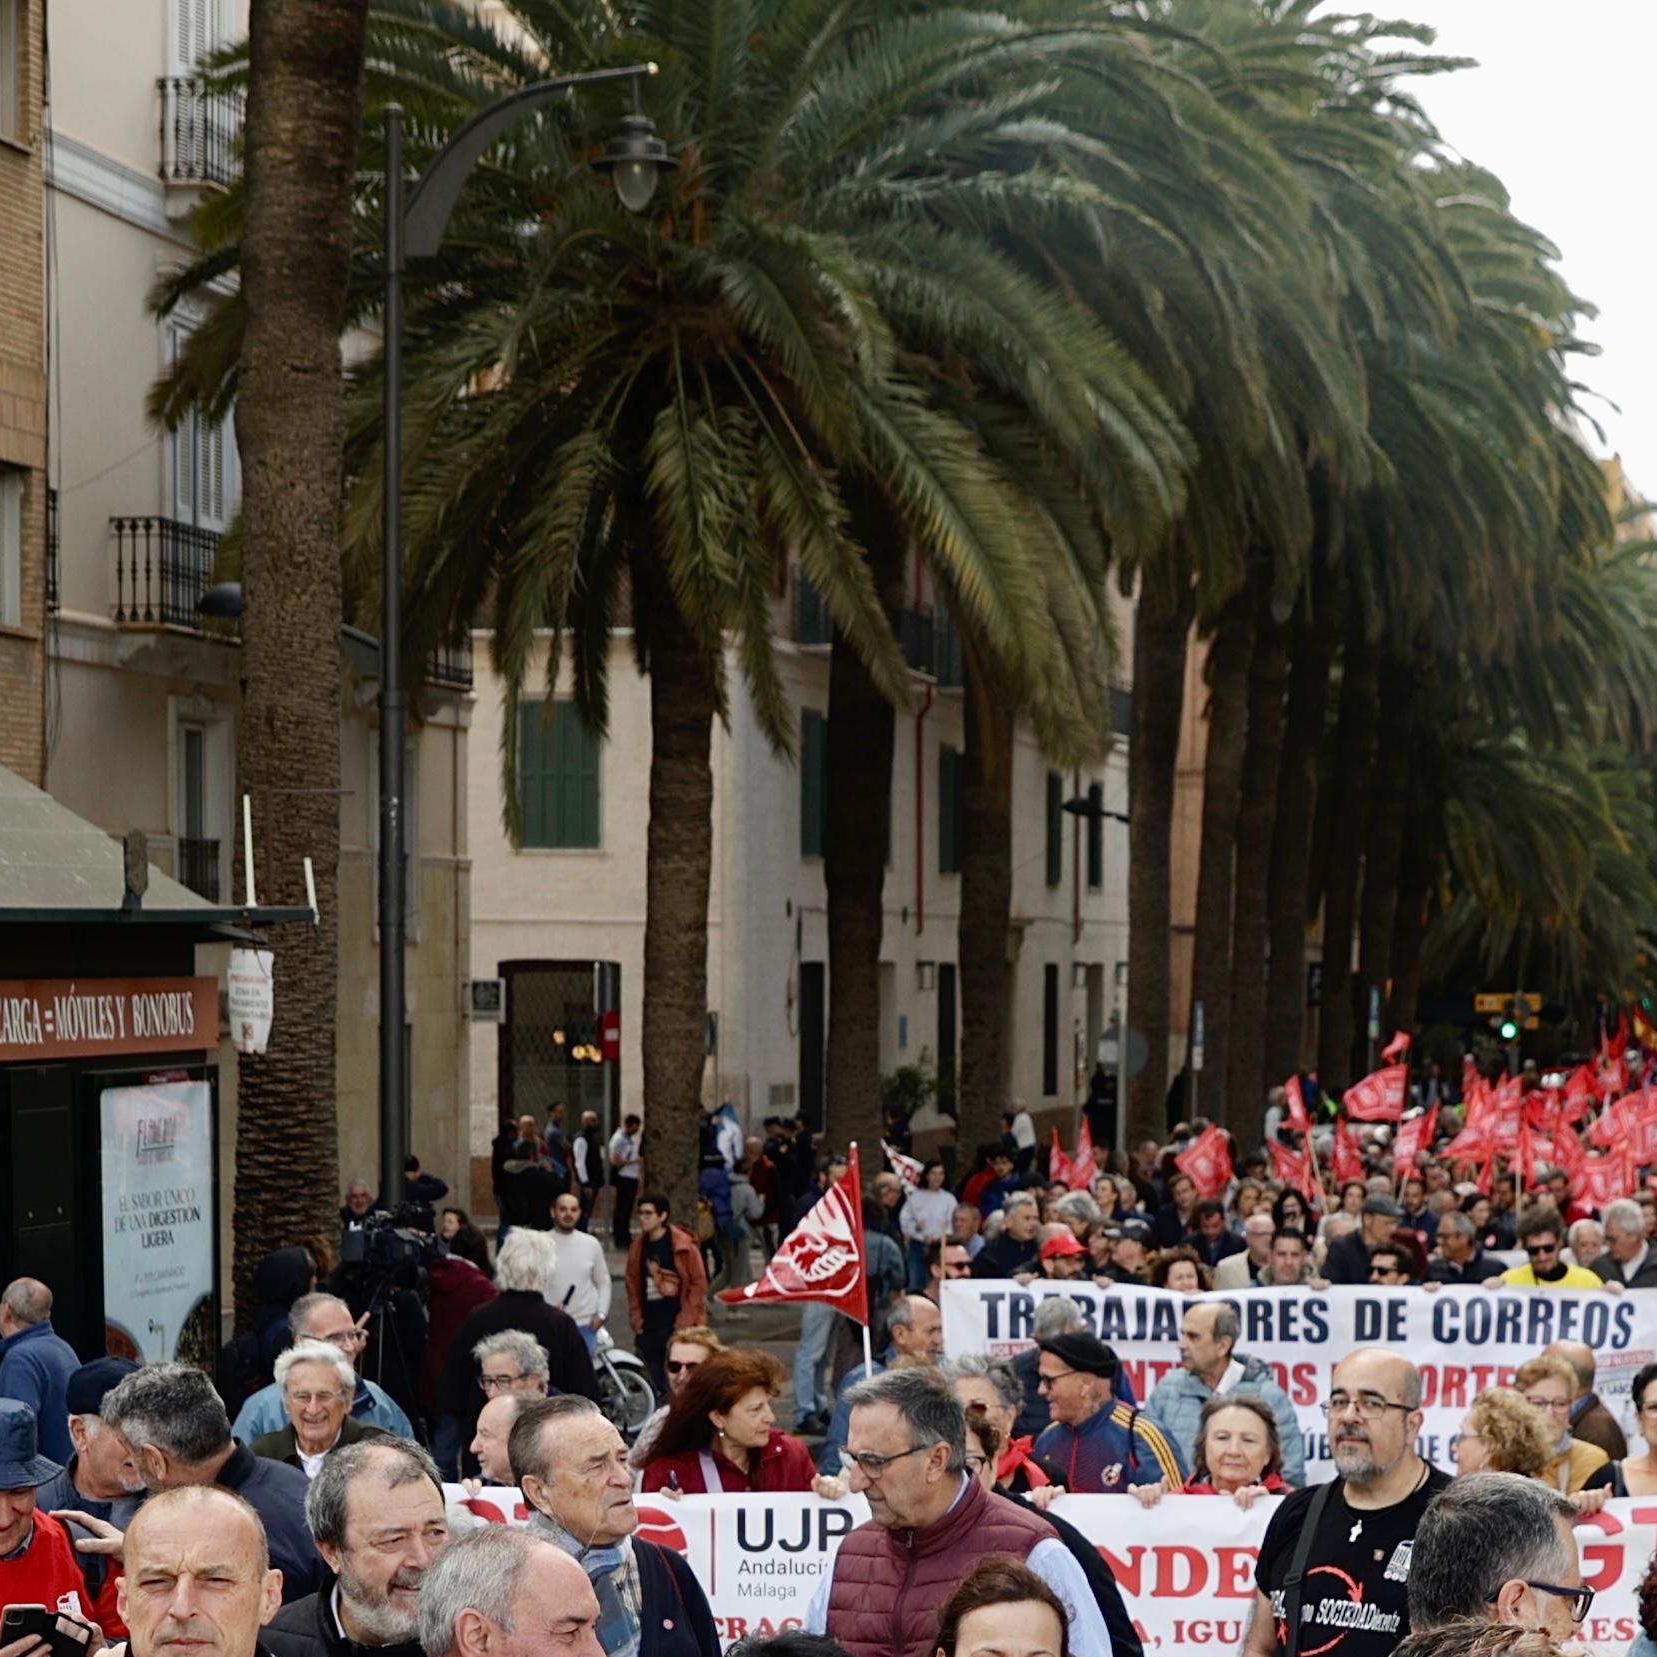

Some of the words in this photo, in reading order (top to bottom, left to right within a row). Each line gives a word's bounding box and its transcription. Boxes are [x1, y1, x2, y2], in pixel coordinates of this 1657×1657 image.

[53, 984, 115, 1040] MÓVILES
[116, 995, 126, 1039] Y
[131, 991, 194, 1036] BONOBUS
[1354, 1298, 1407, 1342] DE
[1432, 1297, 1635, 1350] CORREOS
[737, 1507, 853, 1553] UJP
[738, 1558, 829, 1576] Andalucí
[737, 1582, 797, 1602] Málaga
